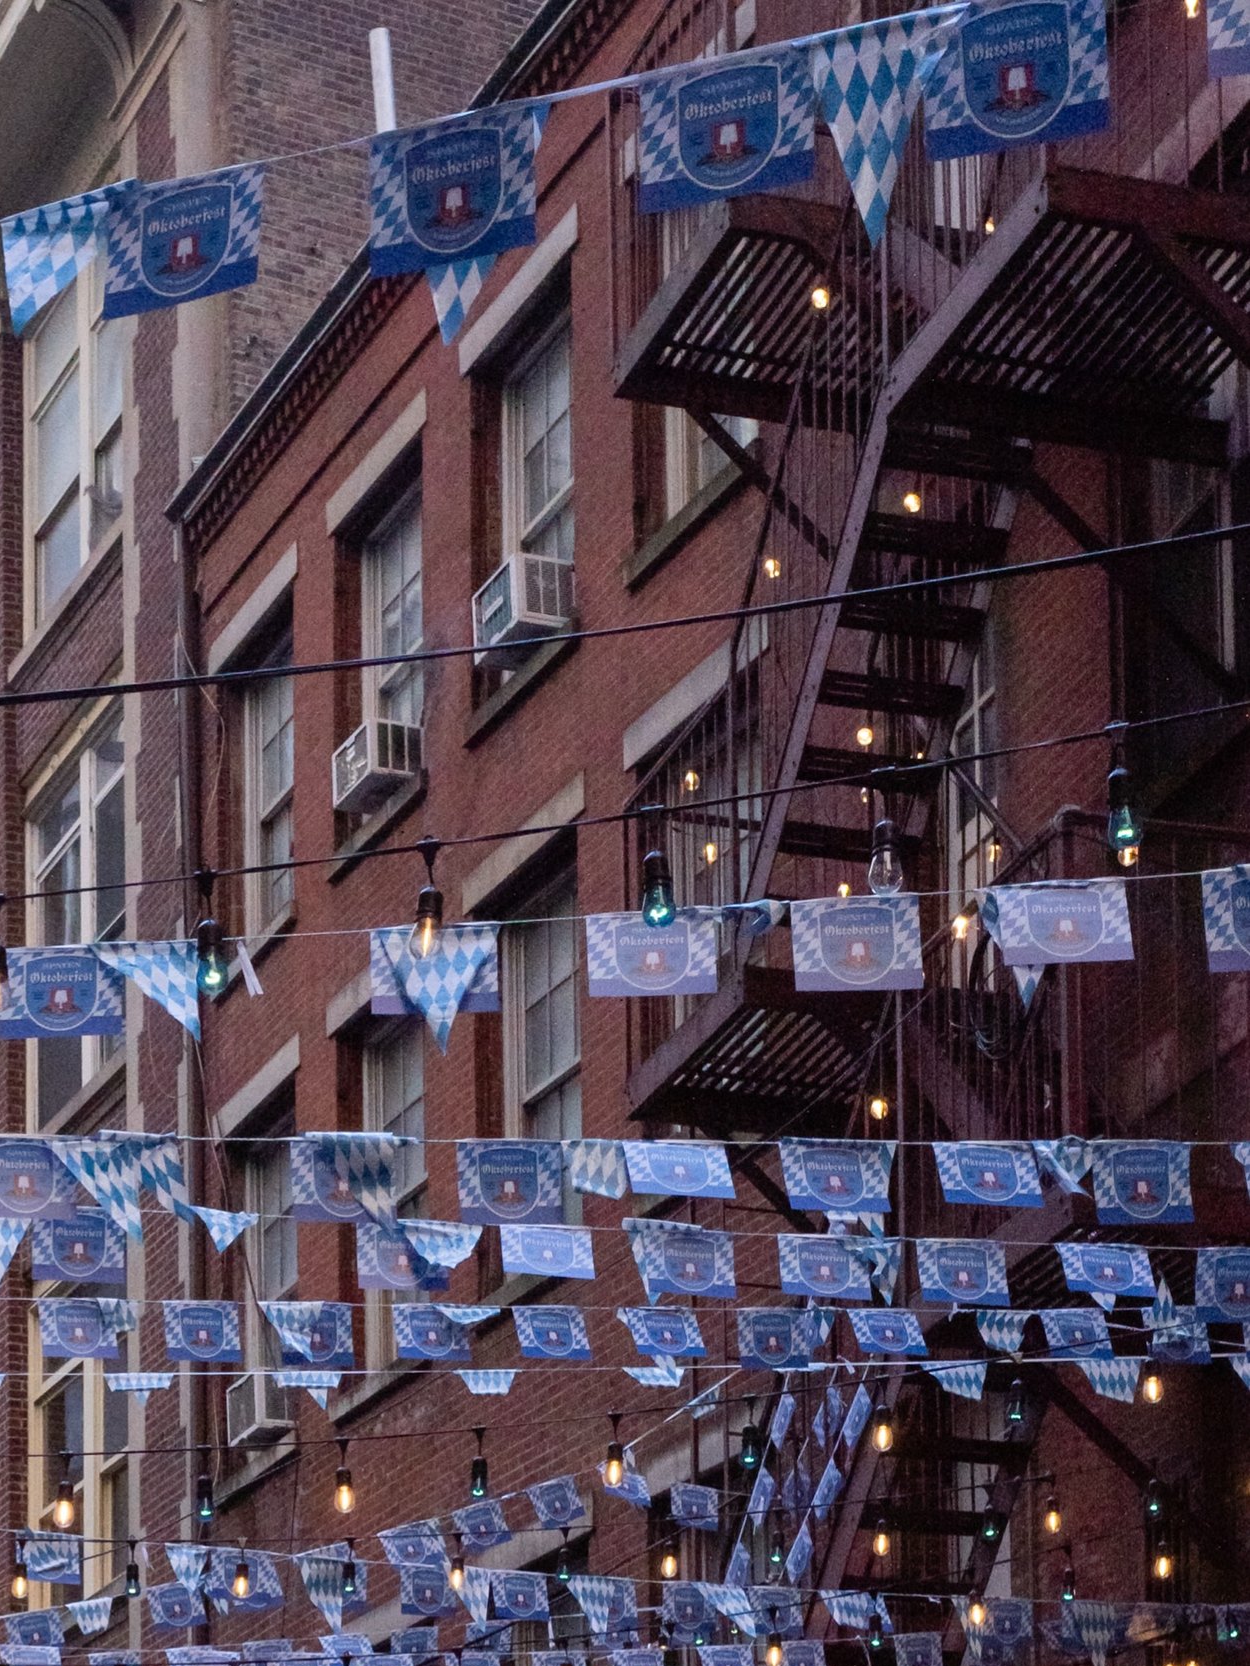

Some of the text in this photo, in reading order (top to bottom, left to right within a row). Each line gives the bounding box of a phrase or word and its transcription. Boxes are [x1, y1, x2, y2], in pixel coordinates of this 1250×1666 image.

[969, 32, 1062, 62] Oktoberfest
[684, 89, 774, 121] Oktoberfest
[412, 153, 496, 184] Oktoberfest
[147, 205, 227, 236] Oktoberfest
[824, 924, 889, 936] Oktoberfest
[30, 971, 93, 984] Oktoberfest
